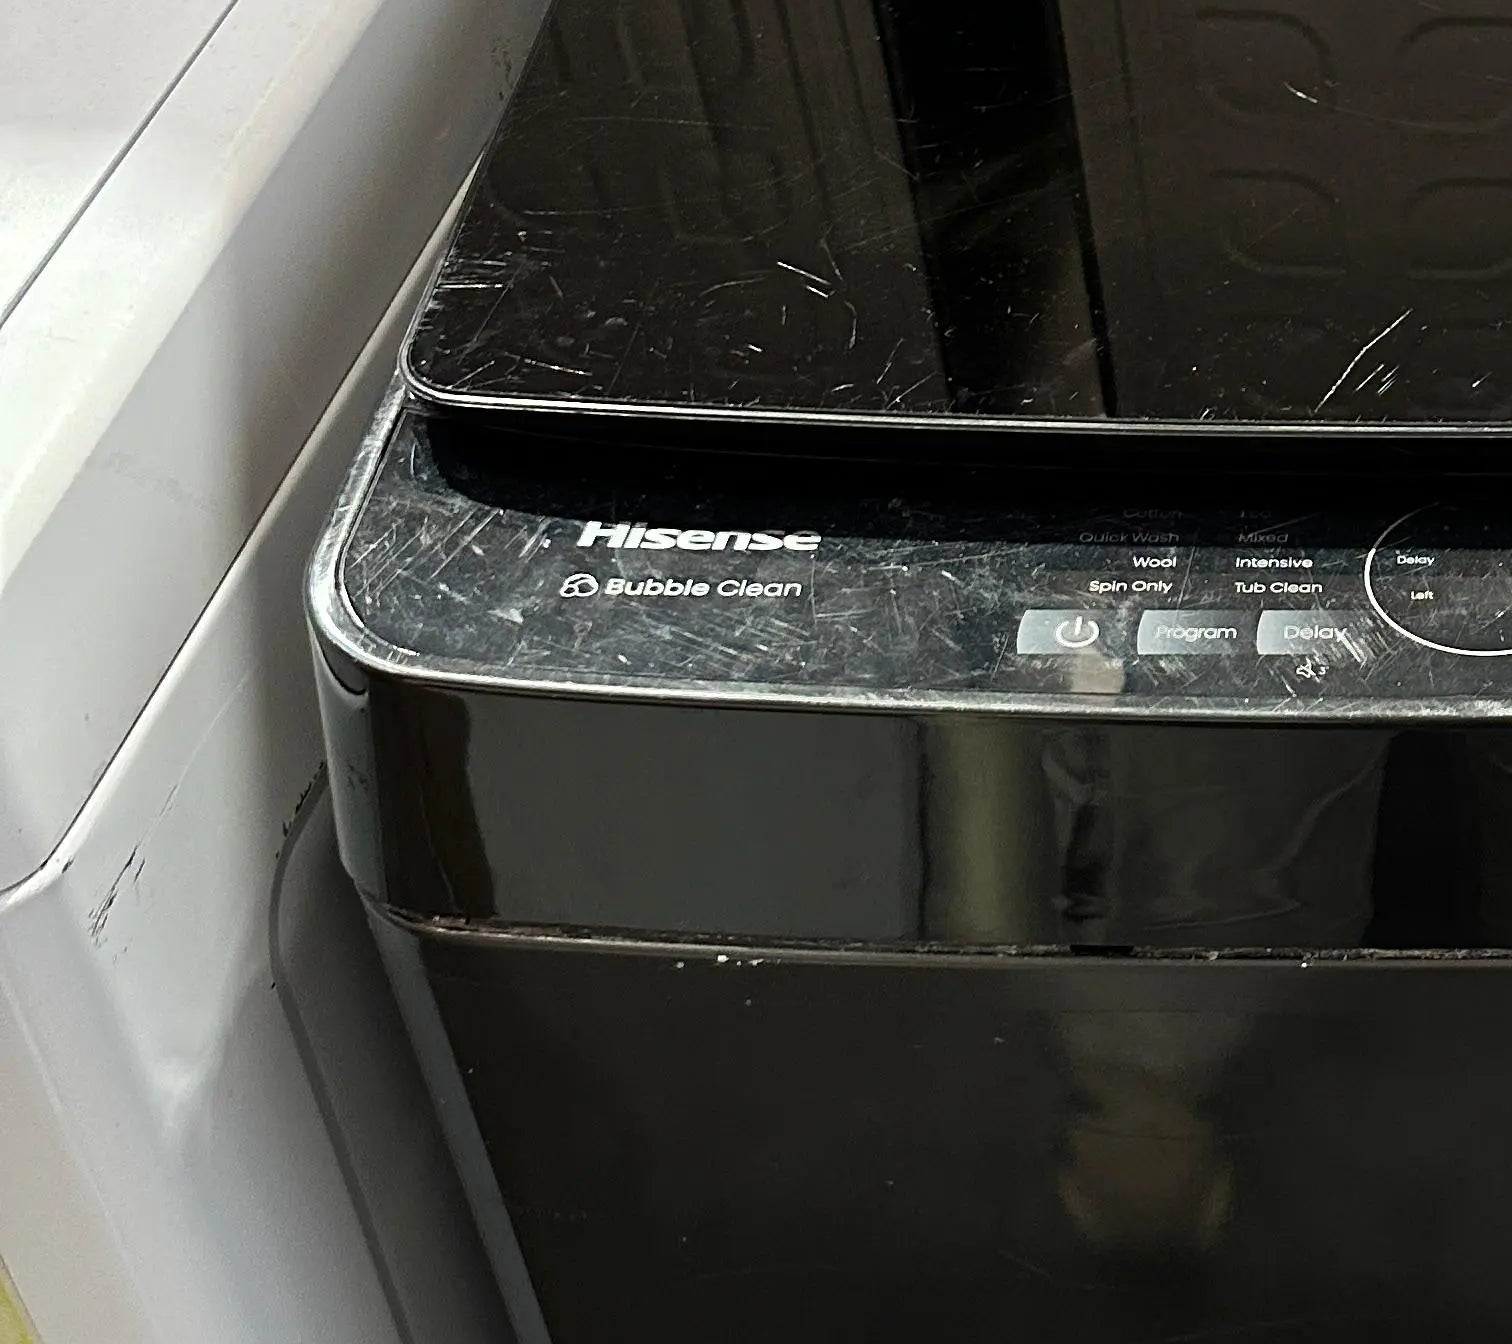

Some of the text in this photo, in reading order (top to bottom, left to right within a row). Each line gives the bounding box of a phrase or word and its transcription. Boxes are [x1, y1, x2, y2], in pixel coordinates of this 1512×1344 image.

[576, 520, 822, 552] Hisense
[1079, 531, 1181, 544] Quick Wash
[1237, 531, 1289, 544] Mixed
[1132, 556, 1178, 569] Wool
[1235, 556, 1314, 569] Intensive
[1396, 555, 1435, 567] Delay
[604, 578, 804, 598] Bubble Clean
[1088, 579, 1174, 595] Spin Only
[1234, 581, 1324, 594] Tub Clean
[1156, 624, 1238, 641] Program
[1283, 624, 1348, 642] Delay
